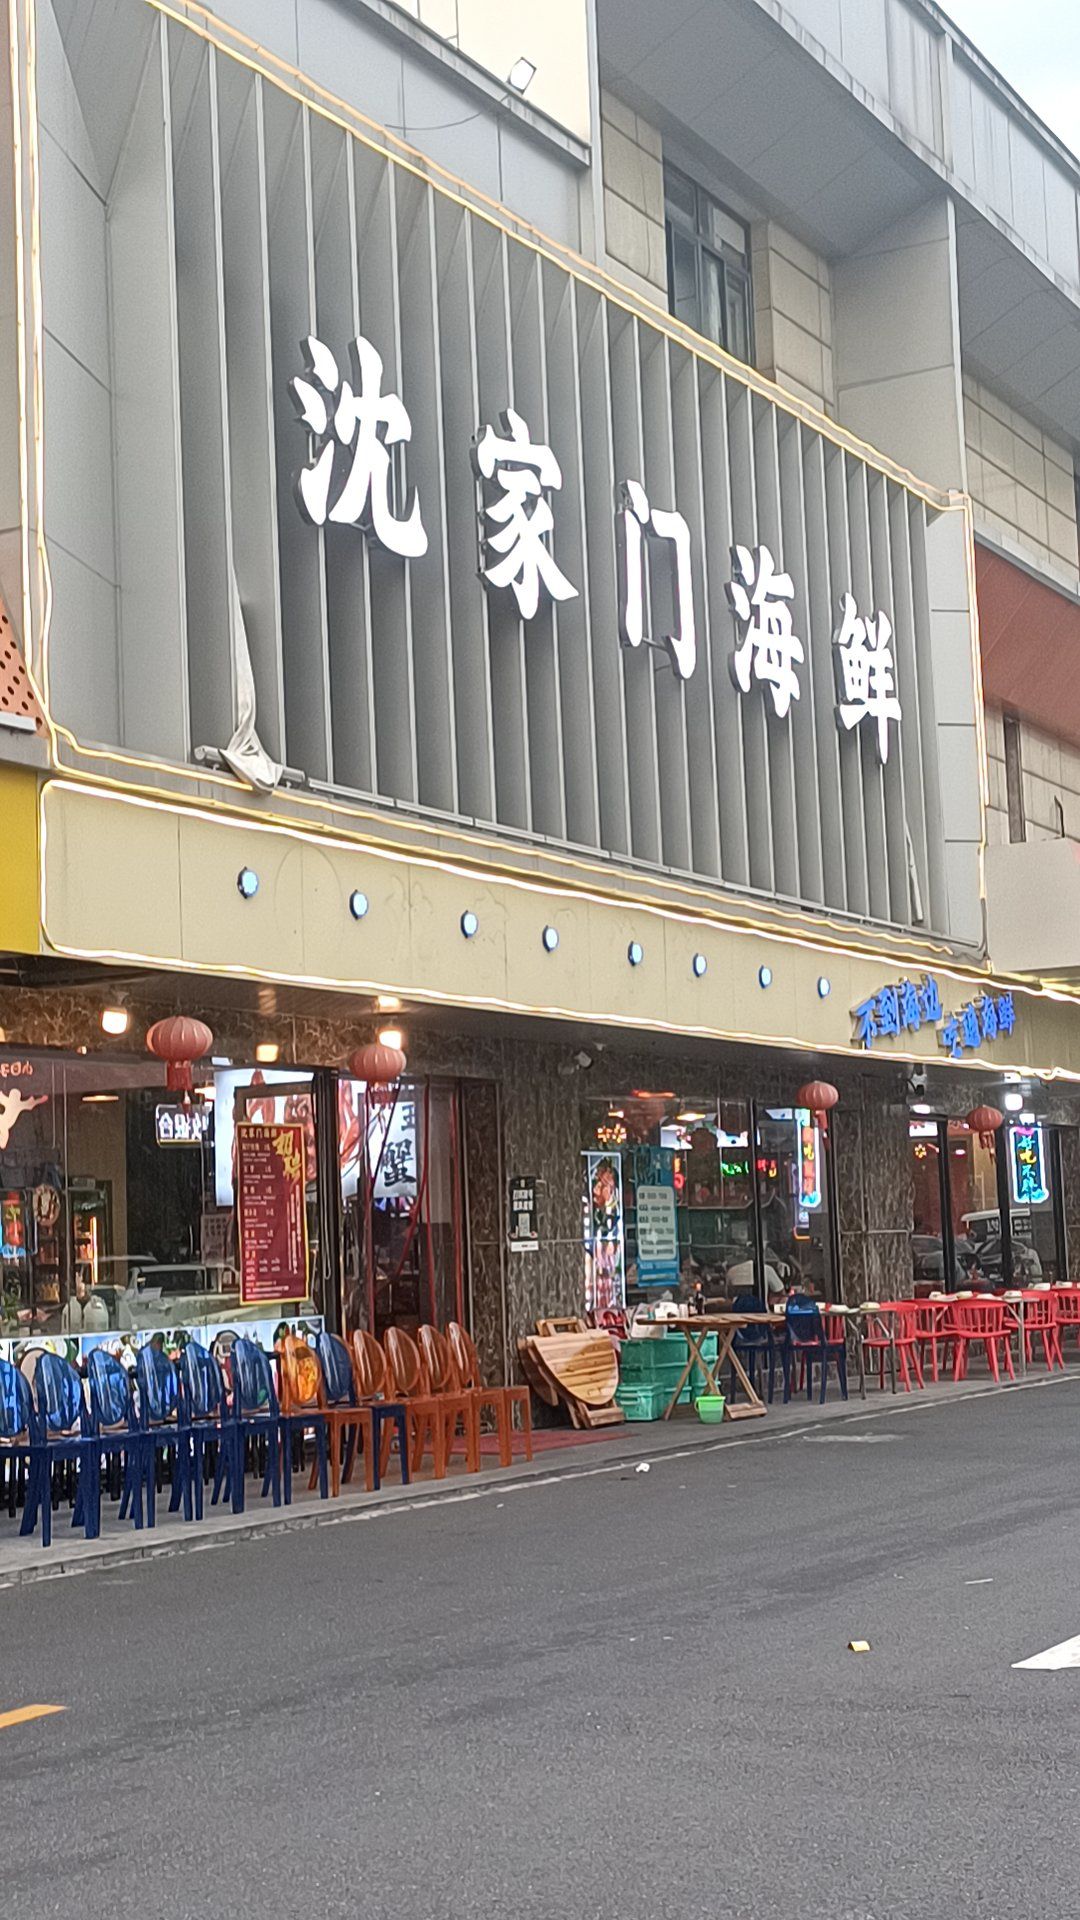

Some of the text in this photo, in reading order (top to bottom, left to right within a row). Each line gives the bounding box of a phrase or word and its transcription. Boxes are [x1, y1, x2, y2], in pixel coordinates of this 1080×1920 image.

[292, 335, 902, 765] 沈家门海鲜
[854, 973, 942, 1049] 不到海边
